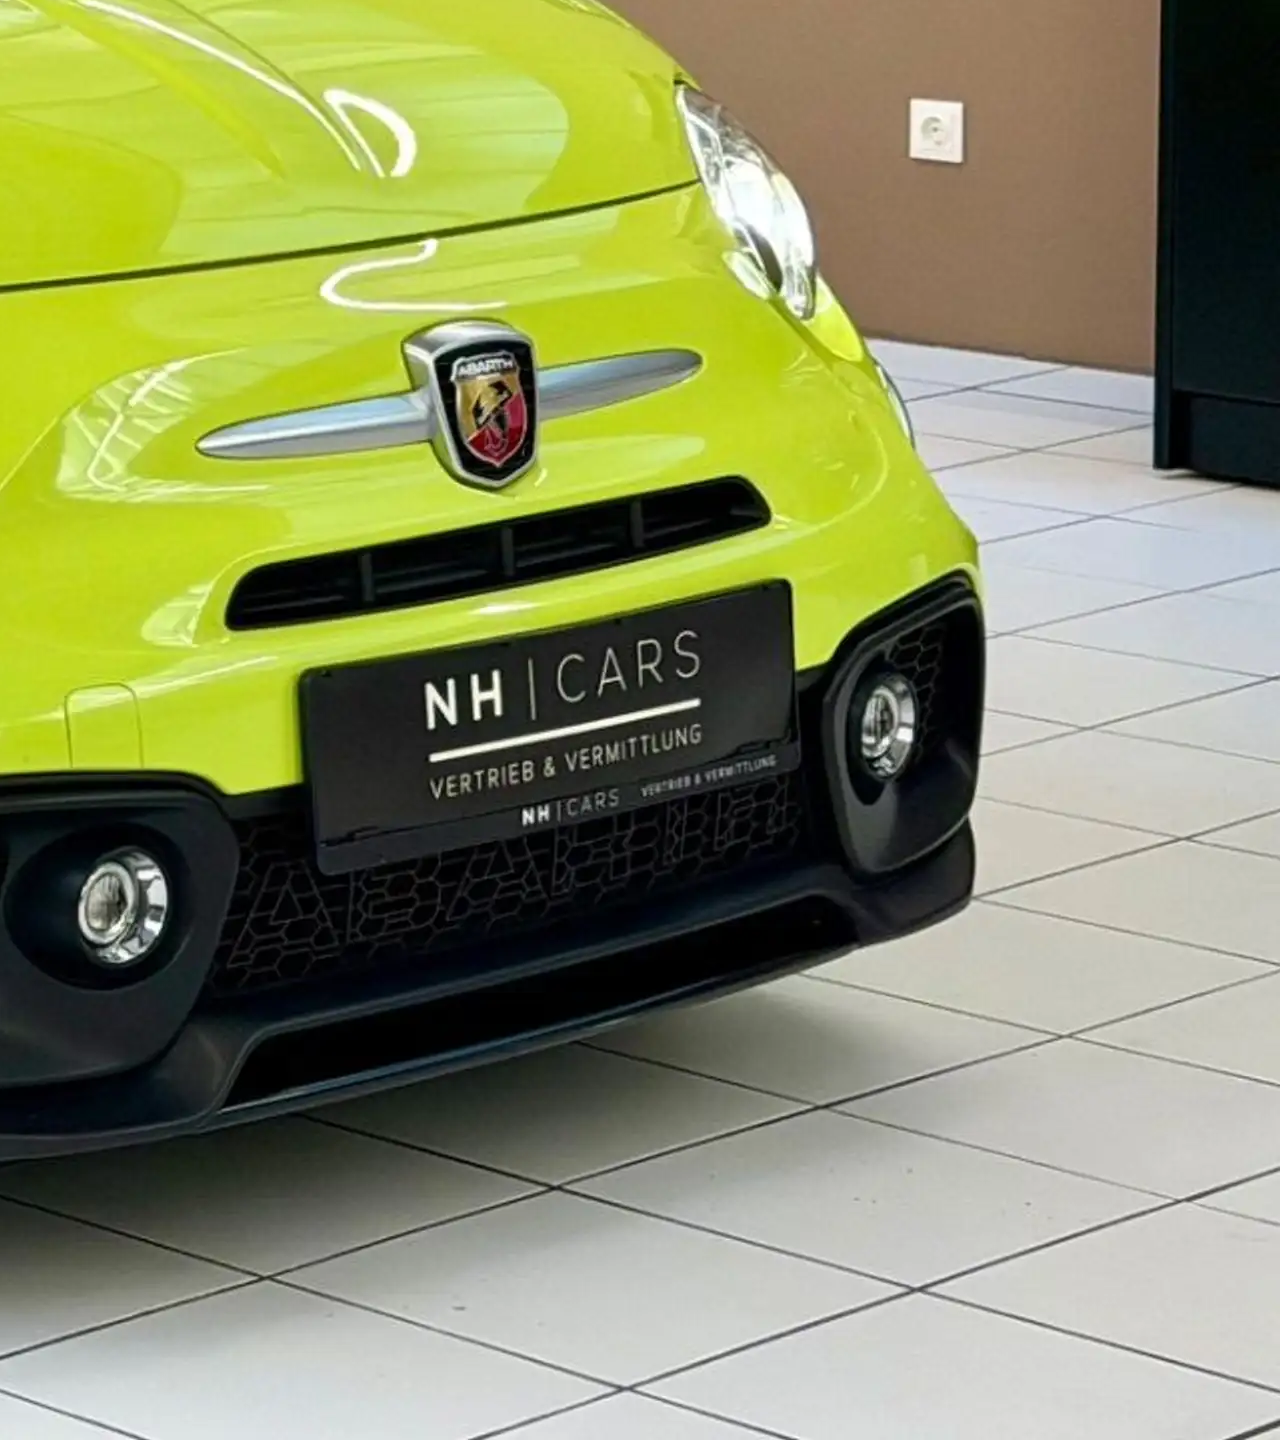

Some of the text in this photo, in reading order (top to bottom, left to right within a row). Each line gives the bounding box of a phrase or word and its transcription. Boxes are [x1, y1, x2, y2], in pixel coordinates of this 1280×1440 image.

[424, 629, 701, 730] NH CARS
[429, 723, 703, 800] VERTRIEB & VERMITTLUNG
[521, 788, 621, 827] NH CARS
